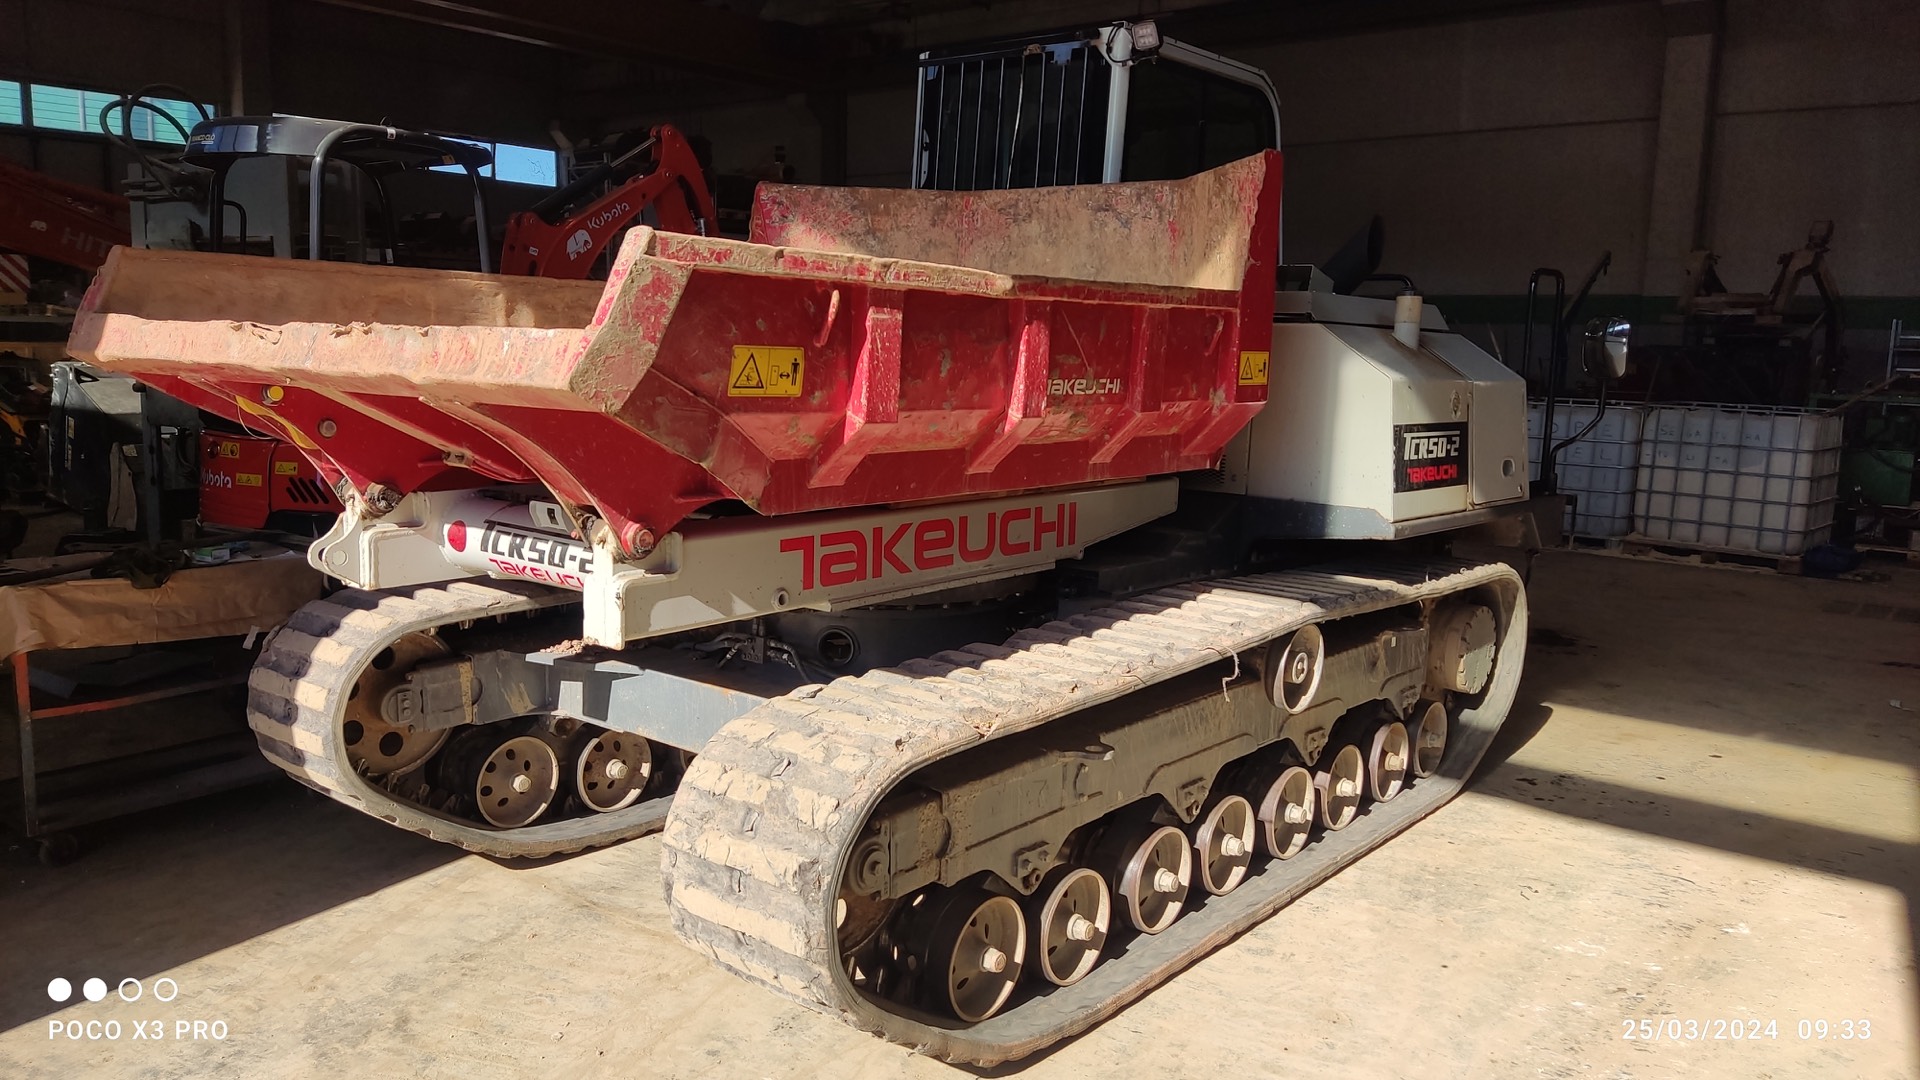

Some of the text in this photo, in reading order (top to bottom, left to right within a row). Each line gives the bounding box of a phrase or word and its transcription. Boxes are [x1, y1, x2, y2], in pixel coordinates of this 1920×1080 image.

[587, 202, 630, 229] Kubota
[61, 227, 113, 258] HIT
[1046, 378, 1120, 396] TAKEUCHI
[1403, 430, 1460, 460] TCR50-2
[1407, 464, 1457, 483] TAKEUCHI
[780, 502, 1077, 590] TAKEUCHI
[488, 558, 584, 588] TAKEUC
